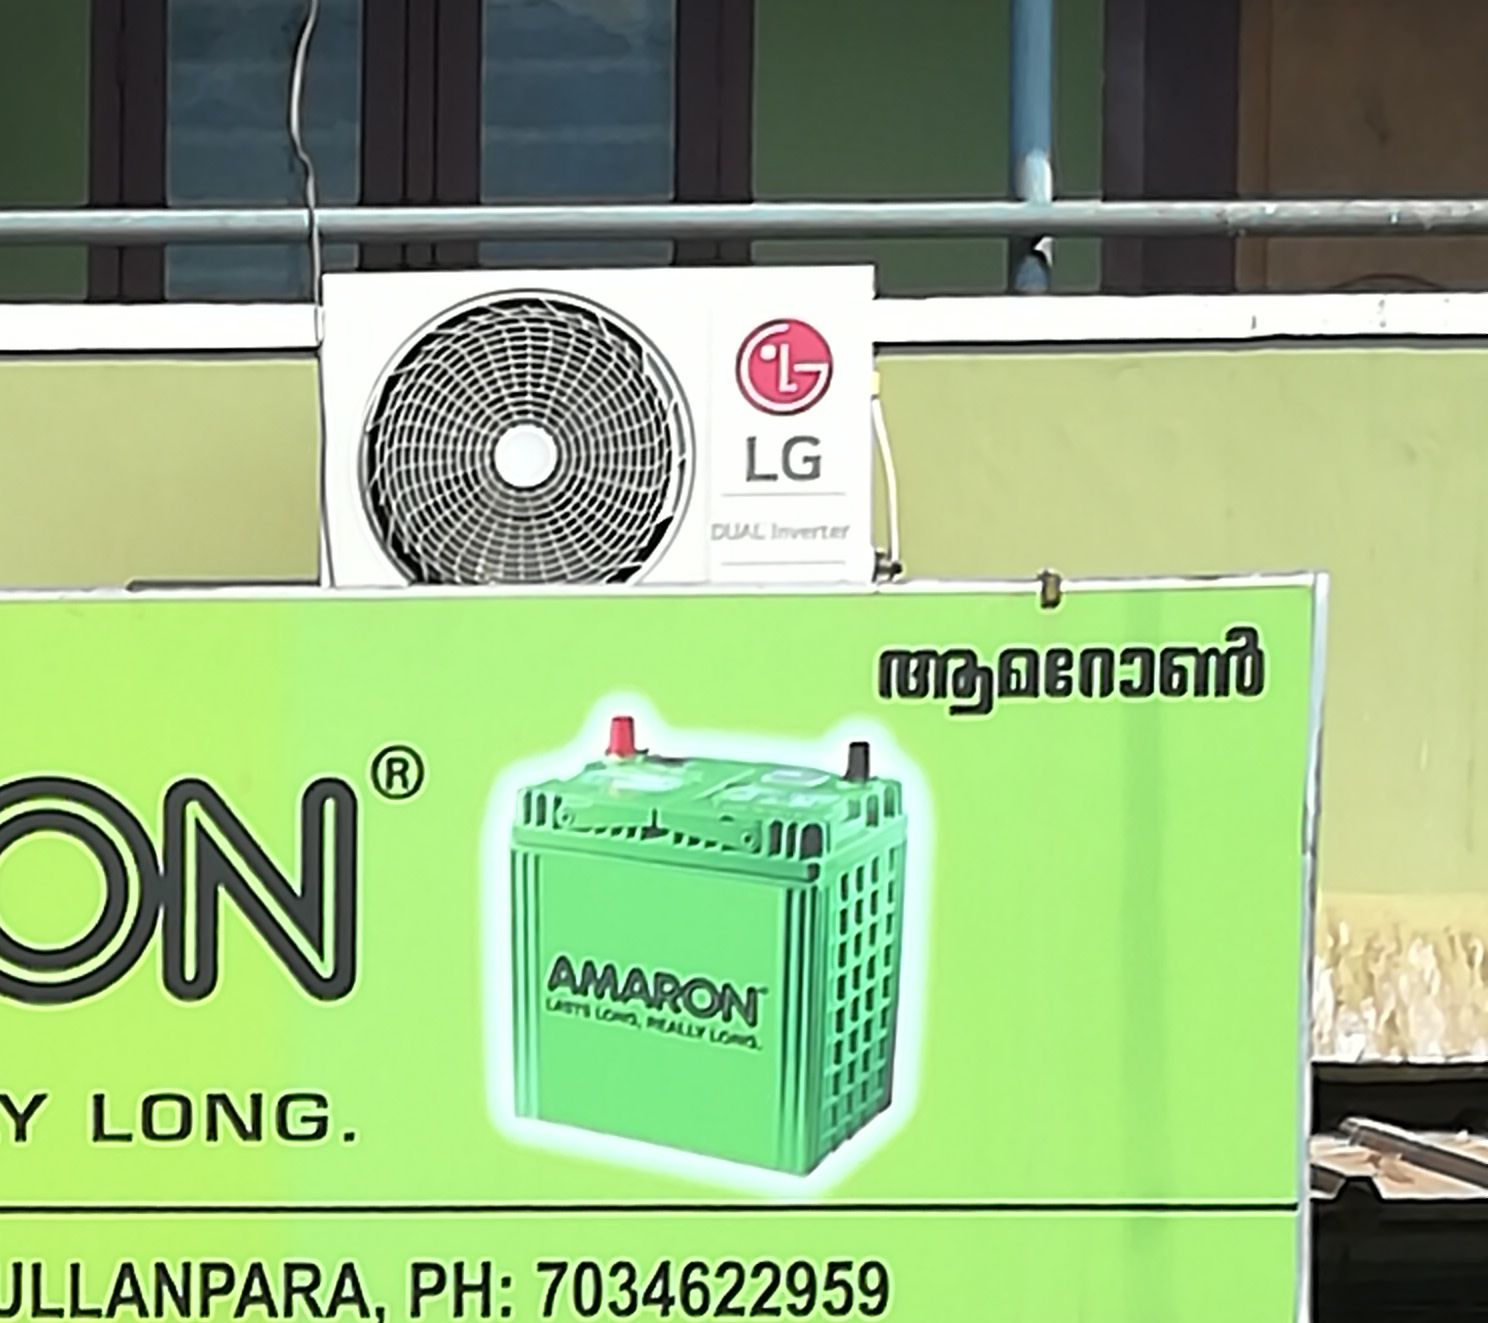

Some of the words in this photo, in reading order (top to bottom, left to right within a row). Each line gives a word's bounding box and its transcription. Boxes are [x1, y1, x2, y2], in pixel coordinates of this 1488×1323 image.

[745, 434, 822, 482] LG
[710, 522, 767, 543] DUAL
[770, 522, 851, 543] Inverter
[547, 954, 759, 1029] AMARON
[92, 1092, 357, 1143] LONG.
[410, 1261, 514, 1320] PH:
[535, 1260, 892, 1320] 7034622959
